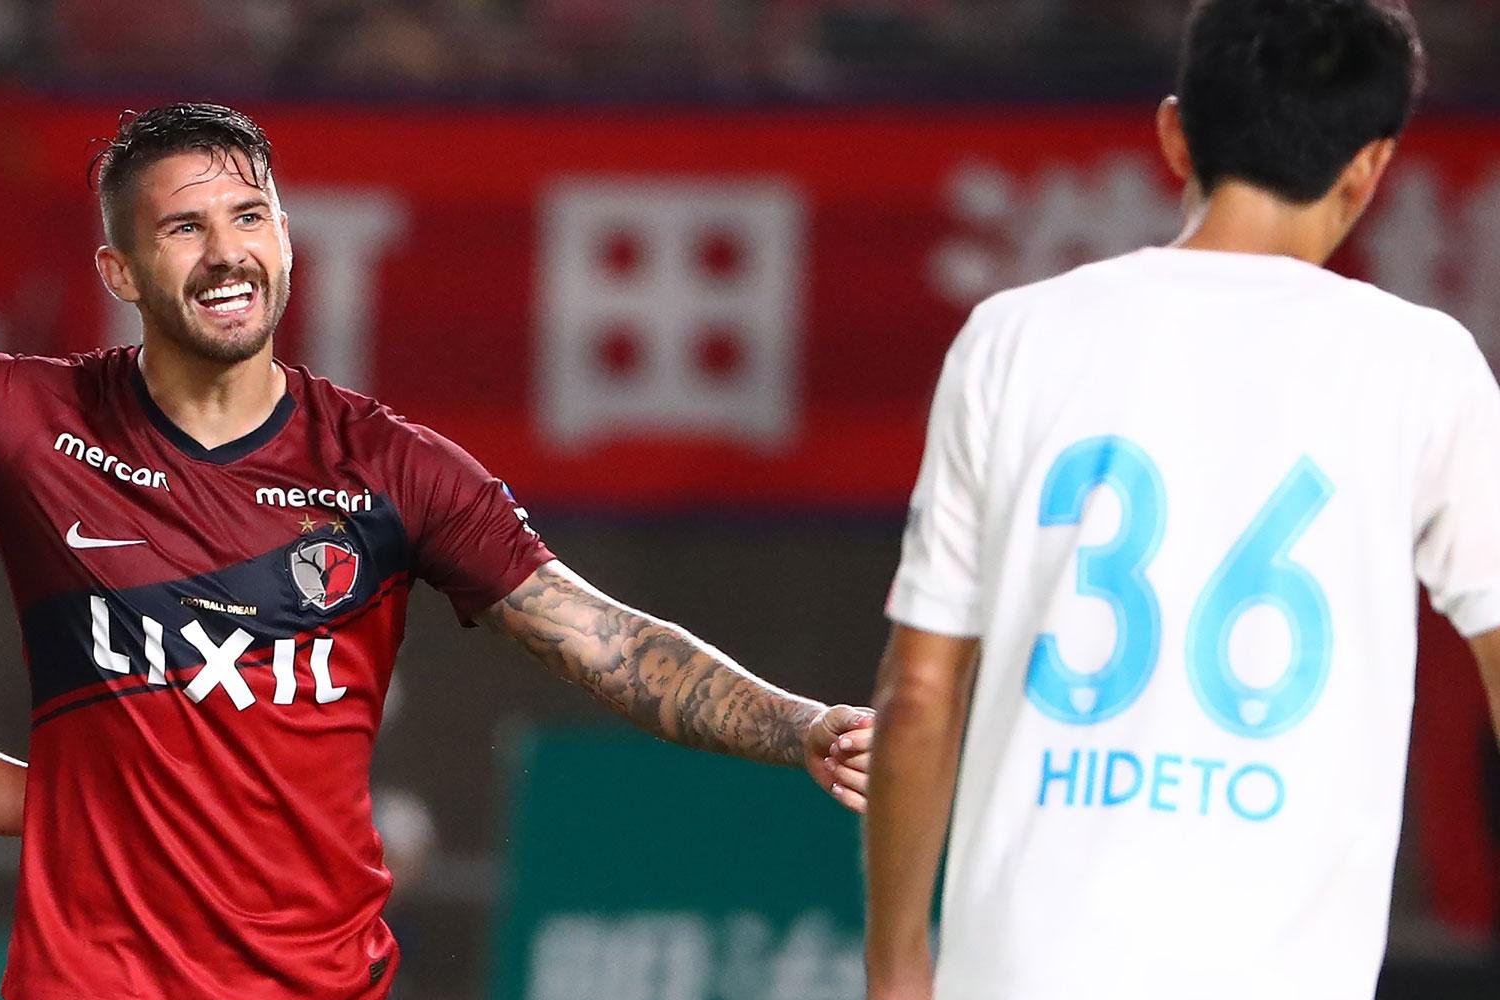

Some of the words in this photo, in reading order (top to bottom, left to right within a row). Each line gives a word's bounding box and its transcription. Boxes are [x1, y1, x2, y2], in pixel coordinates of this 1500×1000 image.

[255, 487, 372, 513] mercari
[180, 597, 226, 612] FOOTBALL
[227, 604, 257, 616] DREAM
[1023, 433, 1336, 740] 36
[90, 595, 348, 712] LIXIL
[1036, 749, 1286, 823] HIDETO
